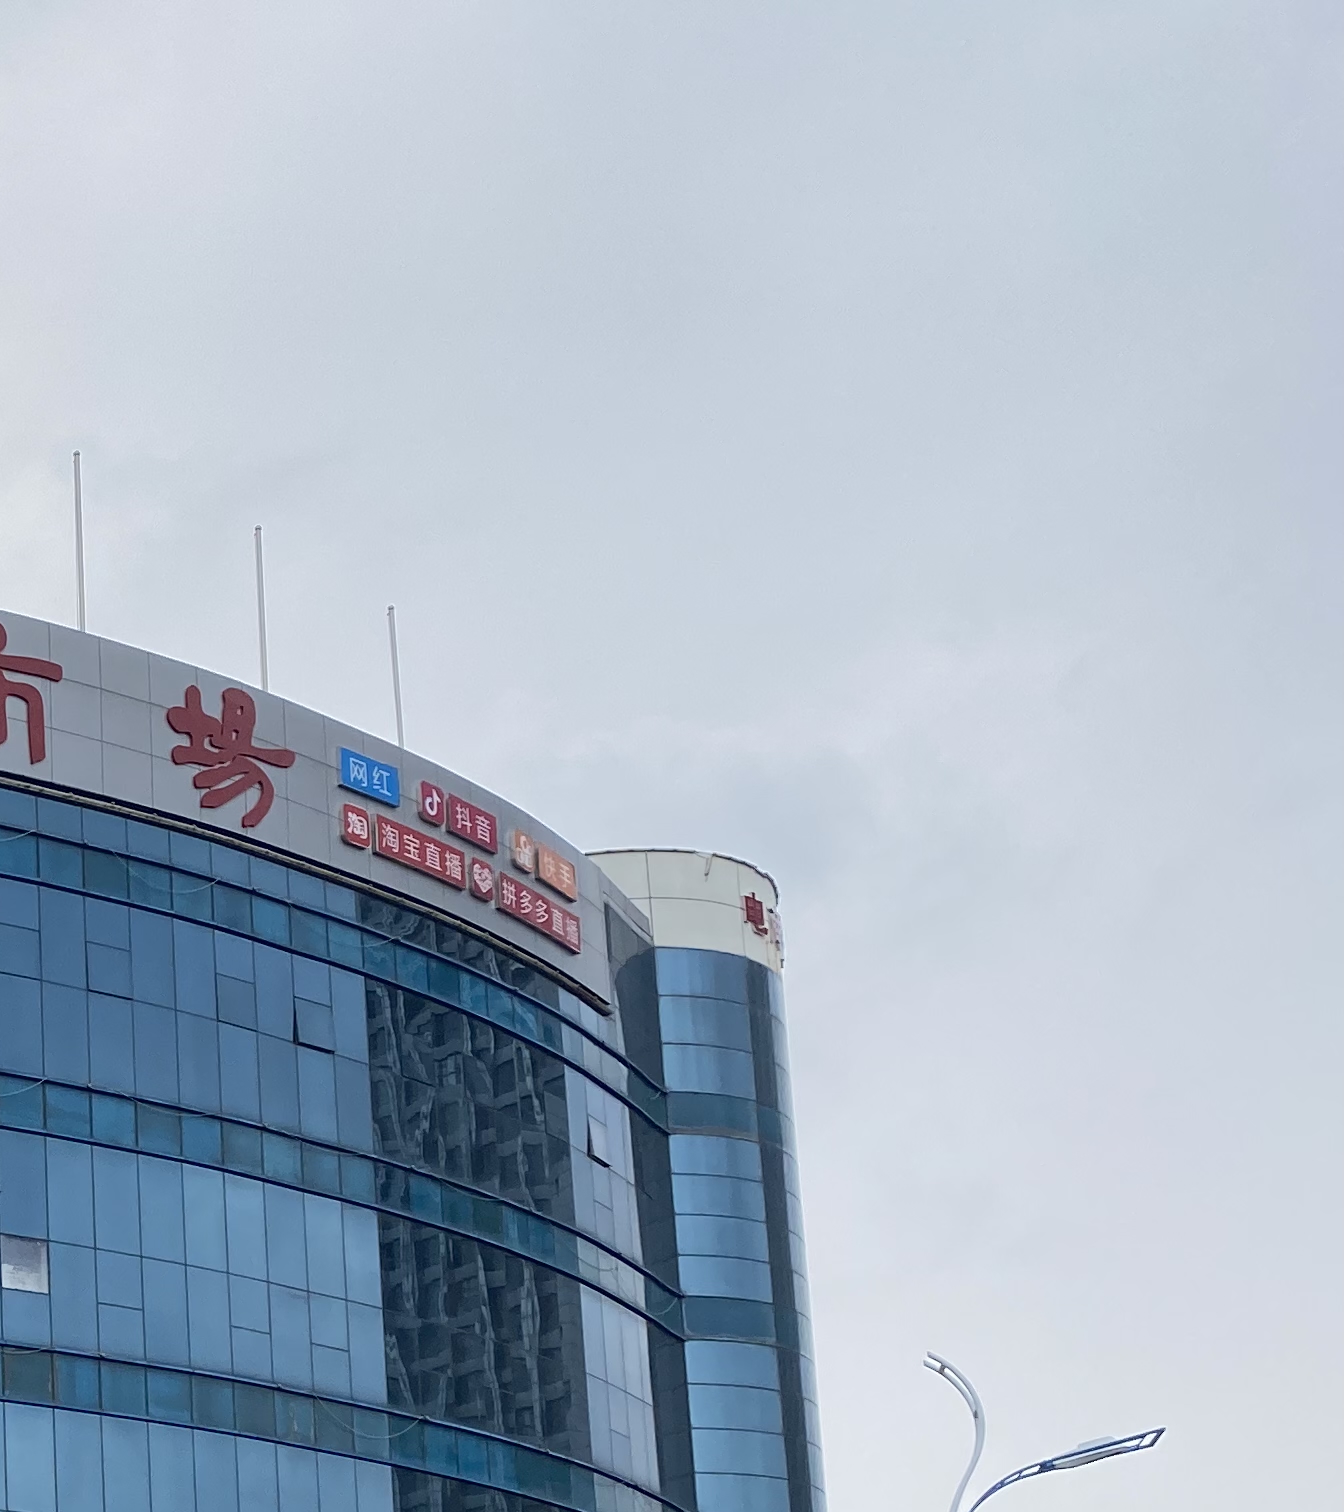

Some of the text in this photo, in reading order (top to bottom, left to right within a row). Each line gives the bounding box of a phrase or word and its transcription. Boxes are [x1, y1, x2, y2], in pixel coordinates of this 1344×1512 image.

[348, 756, 393, 797] 网红
[455, 803, 492, 844] 抖音
[382, 821, 464, 882] 淘宝直播
[501, 878, 579, 946] 拼多多直播
